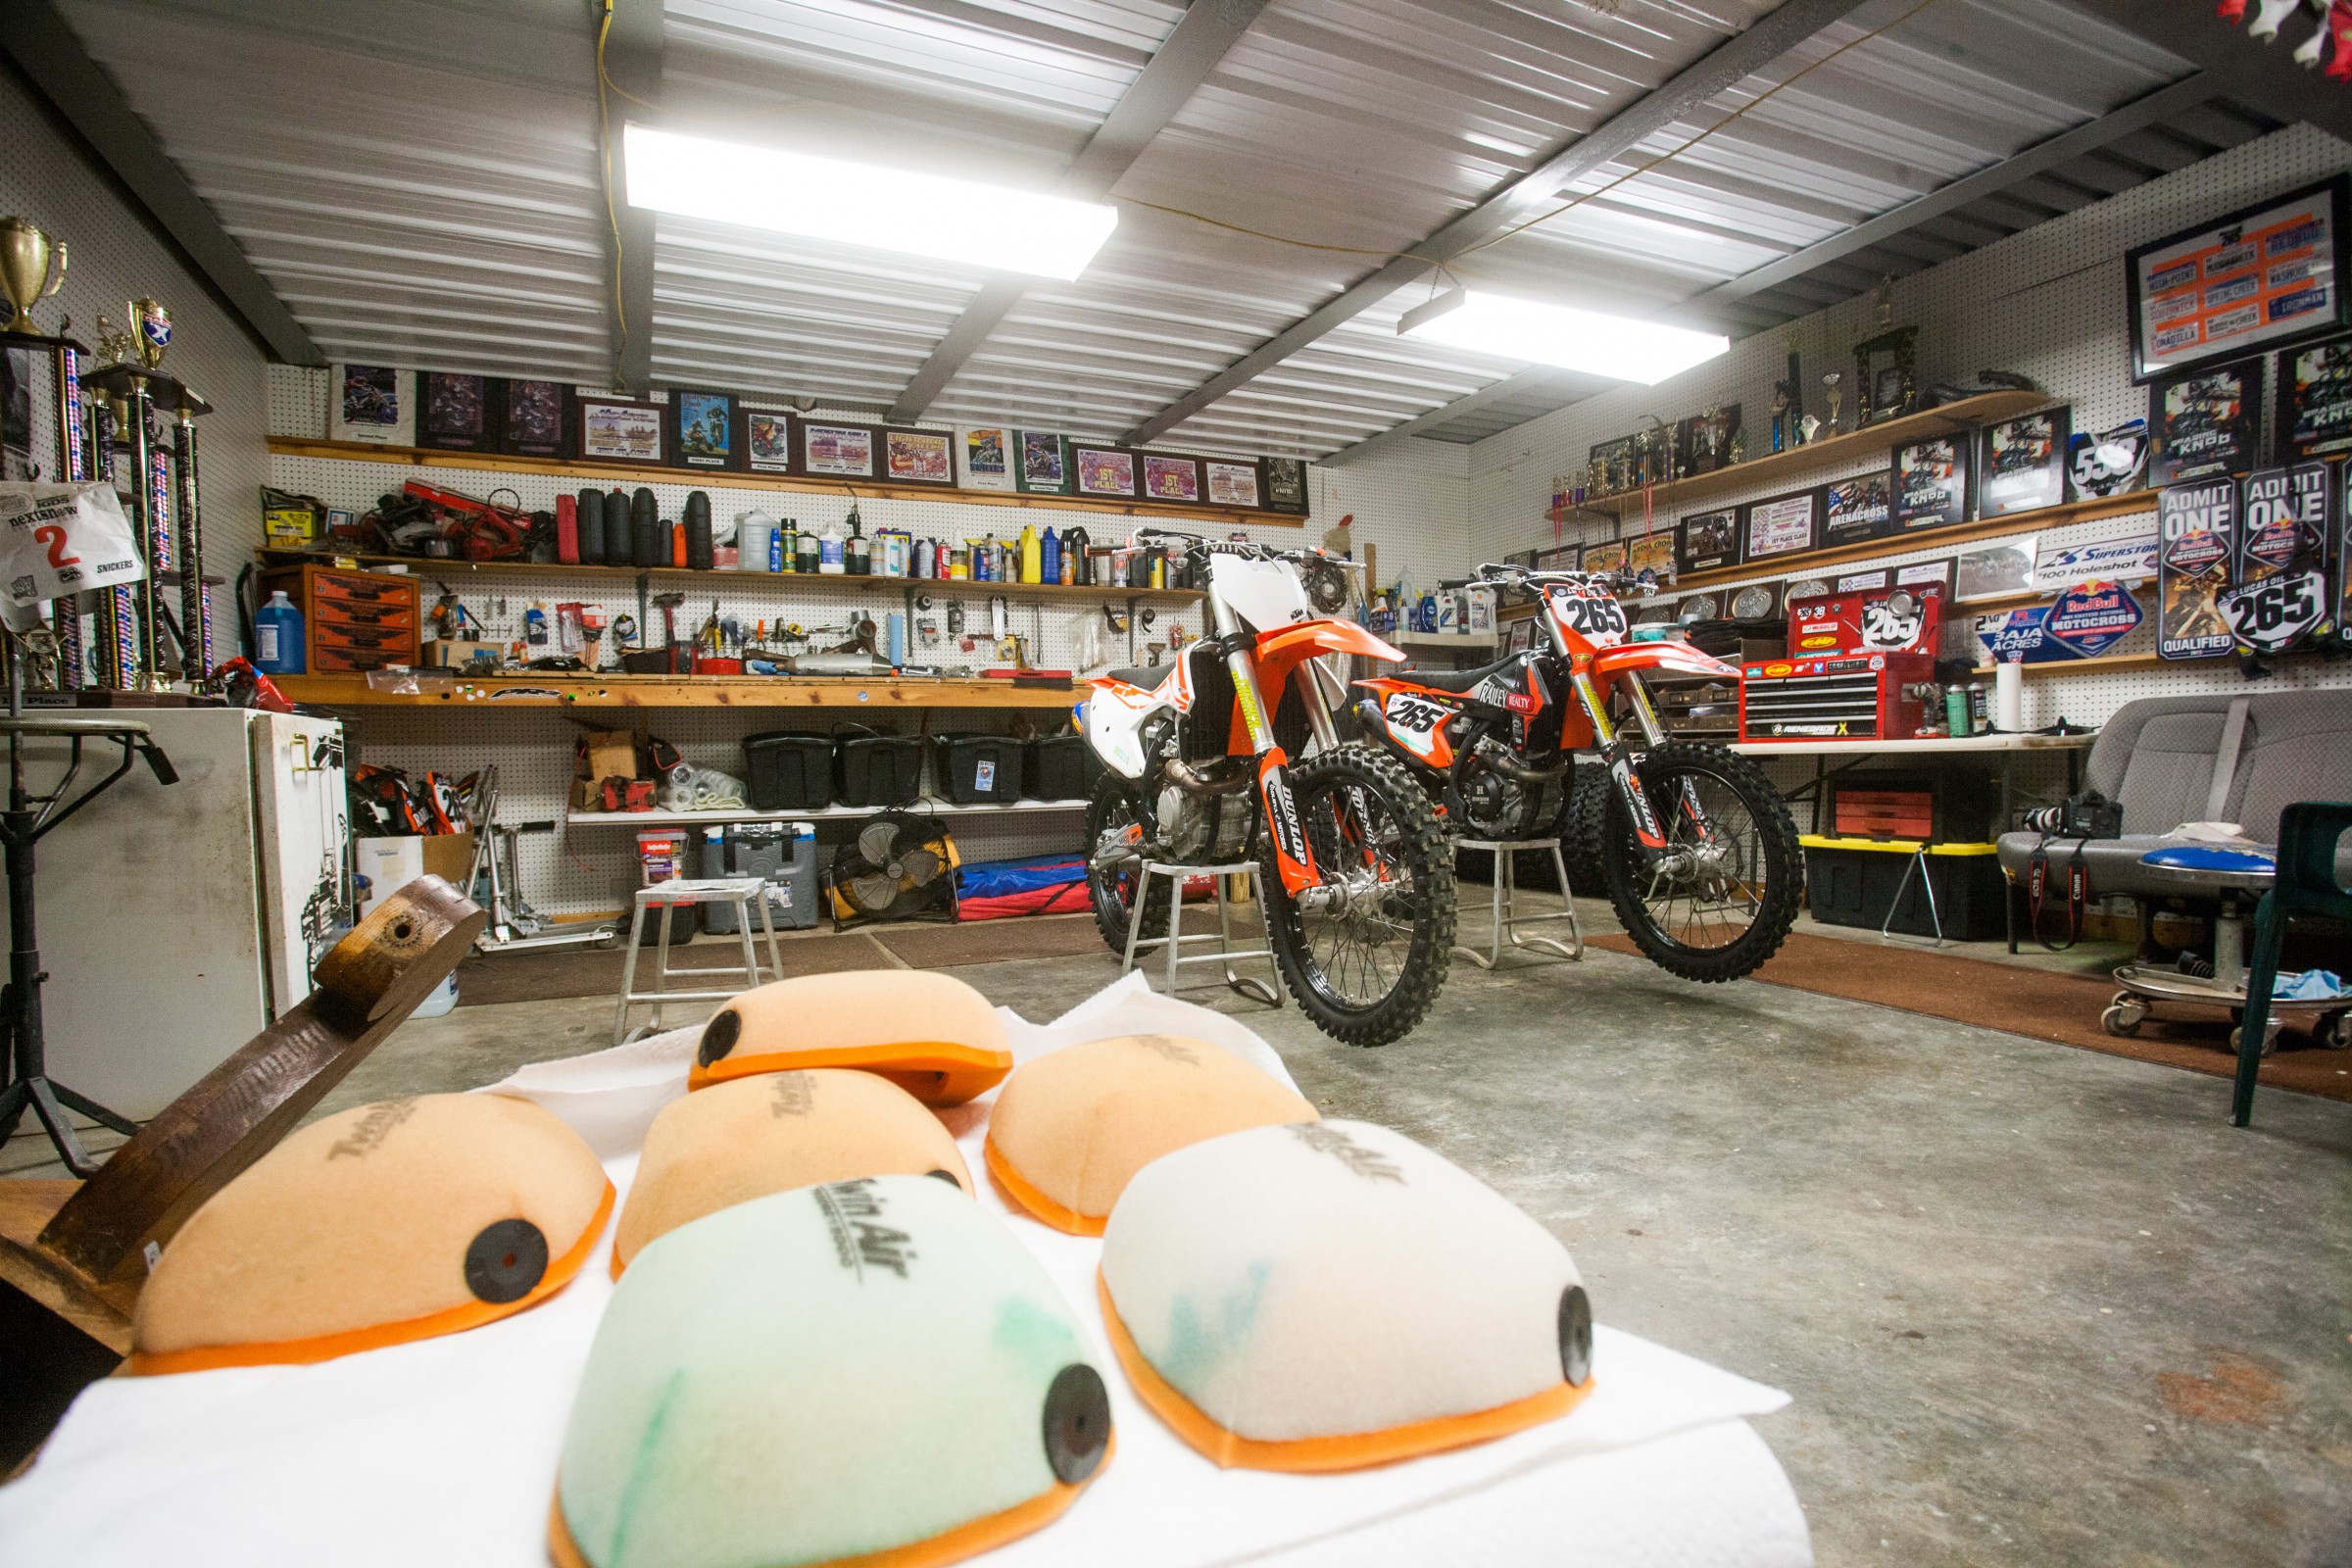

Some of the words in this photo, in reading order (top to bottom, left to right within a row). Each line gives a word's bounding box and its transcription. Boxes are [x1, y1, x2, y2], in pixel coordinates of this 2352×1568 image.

[2179, 433, 2230, 456] KNOB
[1100, 468, 1113, 480] 1ST
[1165, 474, 1178, 486] 1ST
[2165, 484, 2231, 514] ADMIT
[1829, 505, 1888, 526] ARENACROSS
[2165, 504, 2230, 541] ONE
[34, 524, 81, 569] 2
[97, 560, 133, 574] SNICKERS
[2070, 560, 2138, 576] Holeshot
[2239, 582, 2267, 594] LUCAS
[2270, 576, 2286, 585] OIL
[2067, 601, 2091, 612] Red
[2092, 597, 2119, 610] Bull
[2230, 578, 2314, 636] 265
[1291, 609, 1304, 620] KTM
[1566, 599, 1625, 635] 265
[1867, 605, 1919, 641] 265
[1975, 614, 2000, 632] 2ND
[2051, 613, 2136, 631] MOTOCROSS
[1990, 638, 2042, 652] ACRES
[2164, 639, 2231, 653] QUALIFIED
[1479, 683, 1507, 709] RAILEY
[1508, 694, 1530, 710] REALTY
[1386, 701, 1446, 733] 265
[1636, 790, 1660, 839] NLOP
[1282, 785, 1307, 865] DUNLOP
